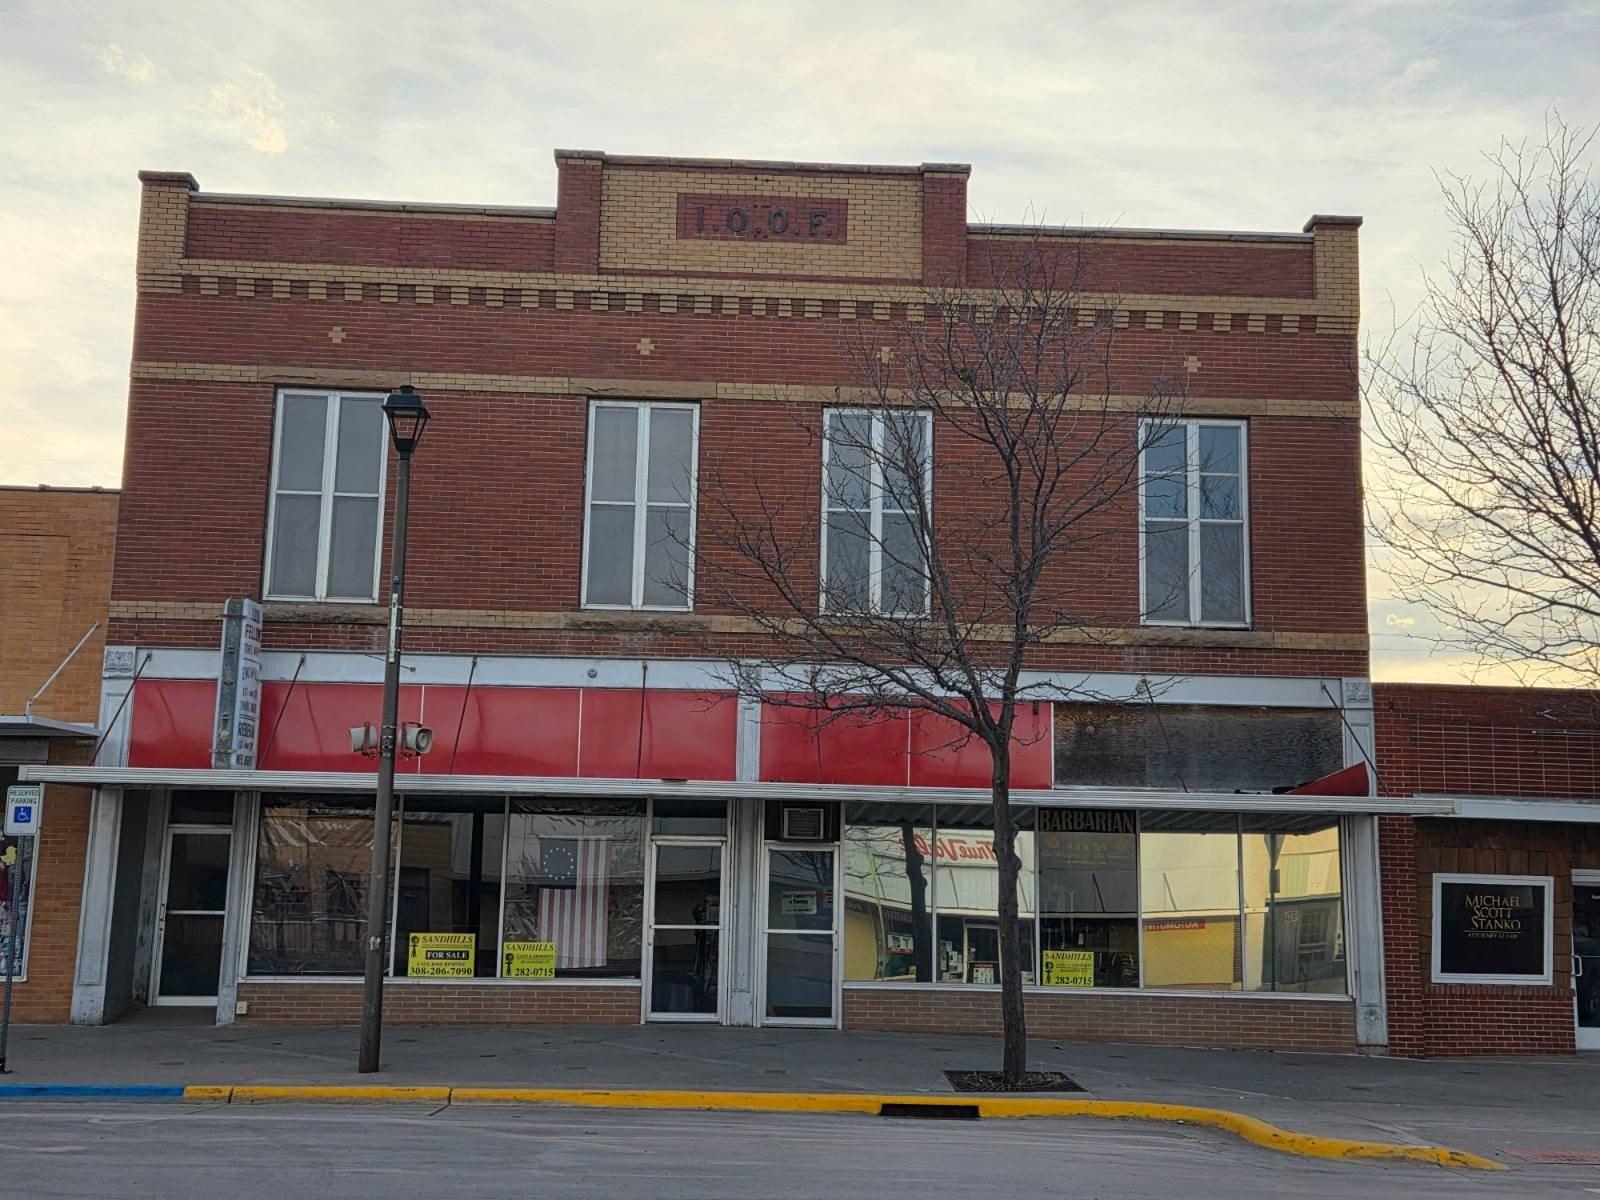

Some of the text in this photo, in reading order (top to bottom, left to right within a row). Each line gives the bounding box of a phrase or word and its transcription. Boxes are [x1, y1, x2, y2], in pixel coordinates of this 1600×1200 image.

[10, 789, 39, 797] RESERVED
[11, 797, 37, 805] PARKING
[1040, 810, 1133, 833] BARBARIAN
[1465, 895, 1521, 907] MICHAEL
[1473, 904, 1513, 918] SCOTT
[1471, 915, 1521, 930] STANKO
[421, 935, 473, 944] SANDHILLS
[505, 943, 554, 952] SANDHILLS
[427, 951, 467, 959] FOR SALE
[1044, 952, 1092, 960] SANDHILLS
[409, 967, 473, 976] 308-206-7090
[515, 968, 554, 976] 282-0715
[1054, 976, 1093, 985] 282-0715
